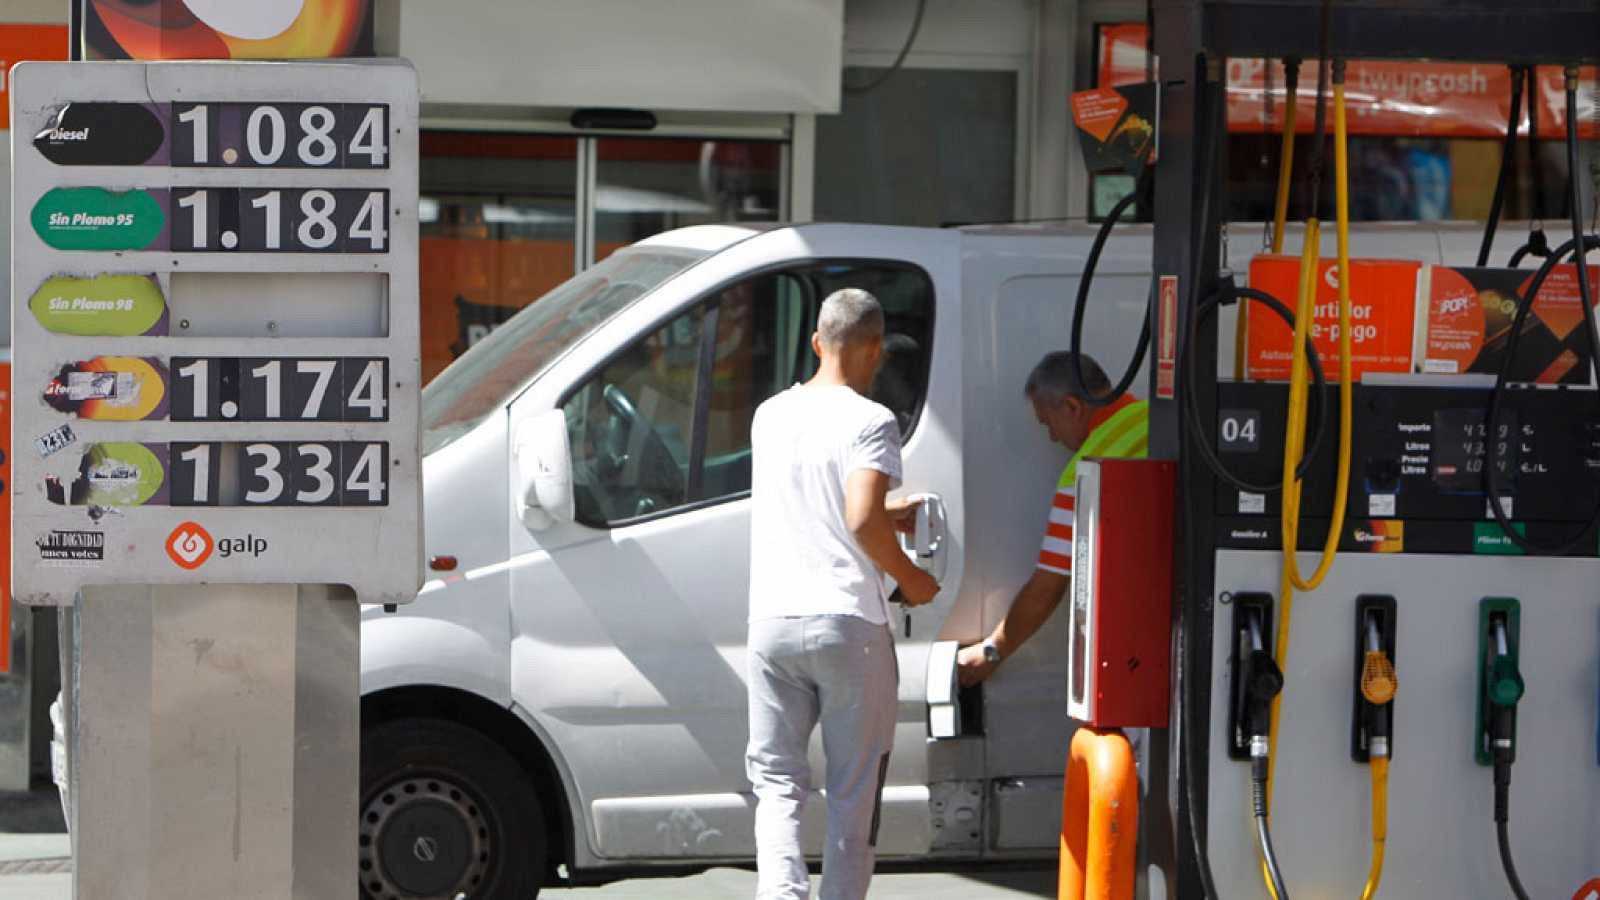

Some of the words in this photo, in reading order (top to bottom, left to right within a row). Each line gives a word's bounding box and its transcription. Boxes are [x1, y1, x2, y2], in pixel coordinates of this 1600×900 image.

[49, 127, 90, 140] Diesel
[178, 104, 388, 165] 1.084
[48, 212, 70, 226] Sin
[72, 212, 115, 226] Plomo
[116, 213, 135, 226] 95
[178, 189, 388, 249] 1.184
[48, 297, 70, 311] Sin
[72, 296, 115, 311] Plomo
[116, 298, 134, 311] 98
[178, 360, 388, 419] 1.174
[1221, 418, 1257, 442] 04
[218, 533, 268, 557] galp
